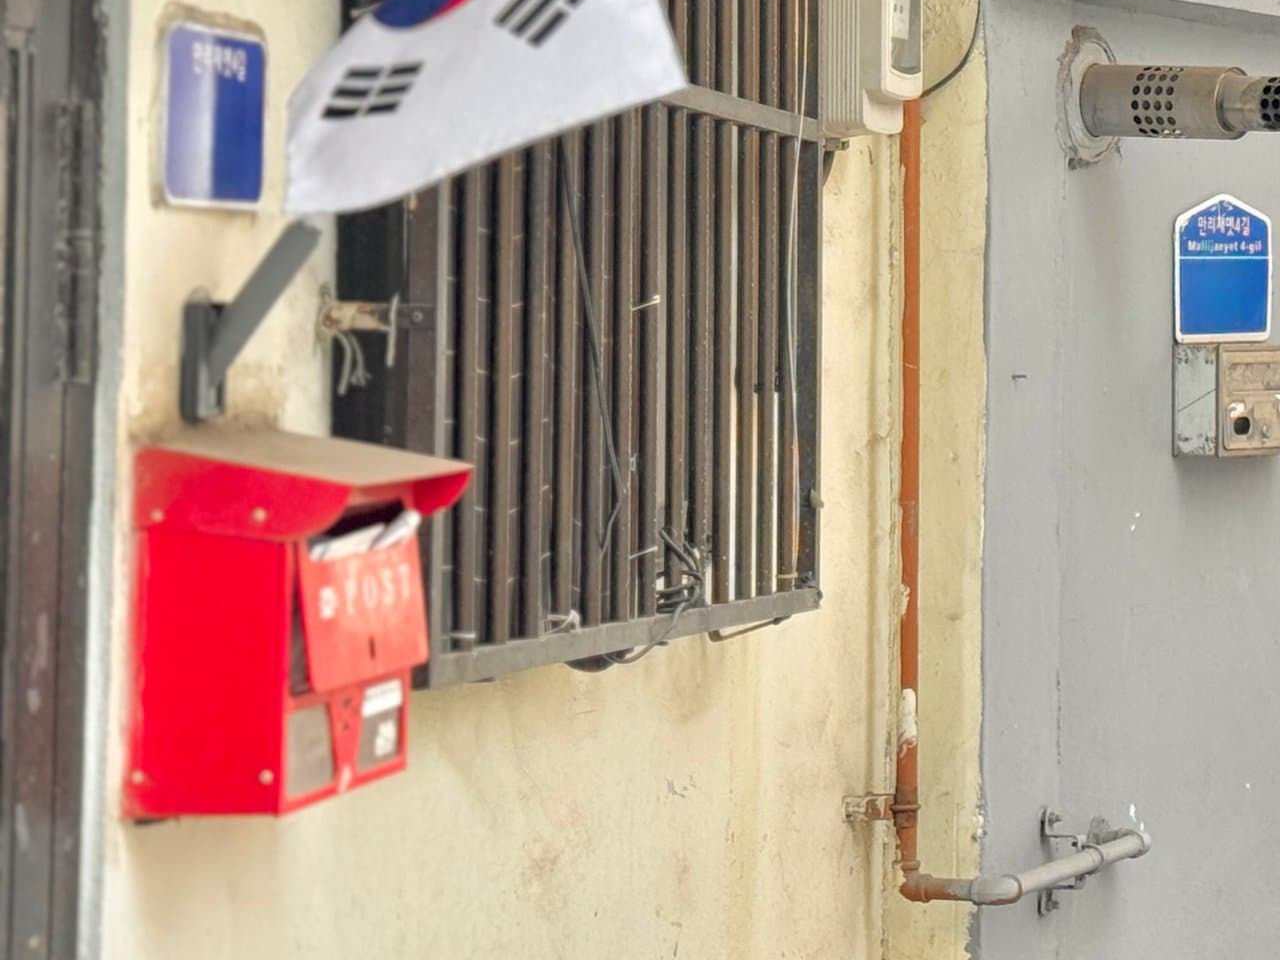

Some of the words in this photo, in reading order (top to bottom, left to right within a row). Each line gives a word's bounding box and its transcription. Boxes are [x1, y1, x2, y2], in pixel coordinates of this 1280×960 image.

[1197, 215, 1251, 237] 만리재옛4길
[1240, 240, 1262, 255] 4-gil
[343, 561, 411, 617] POST
